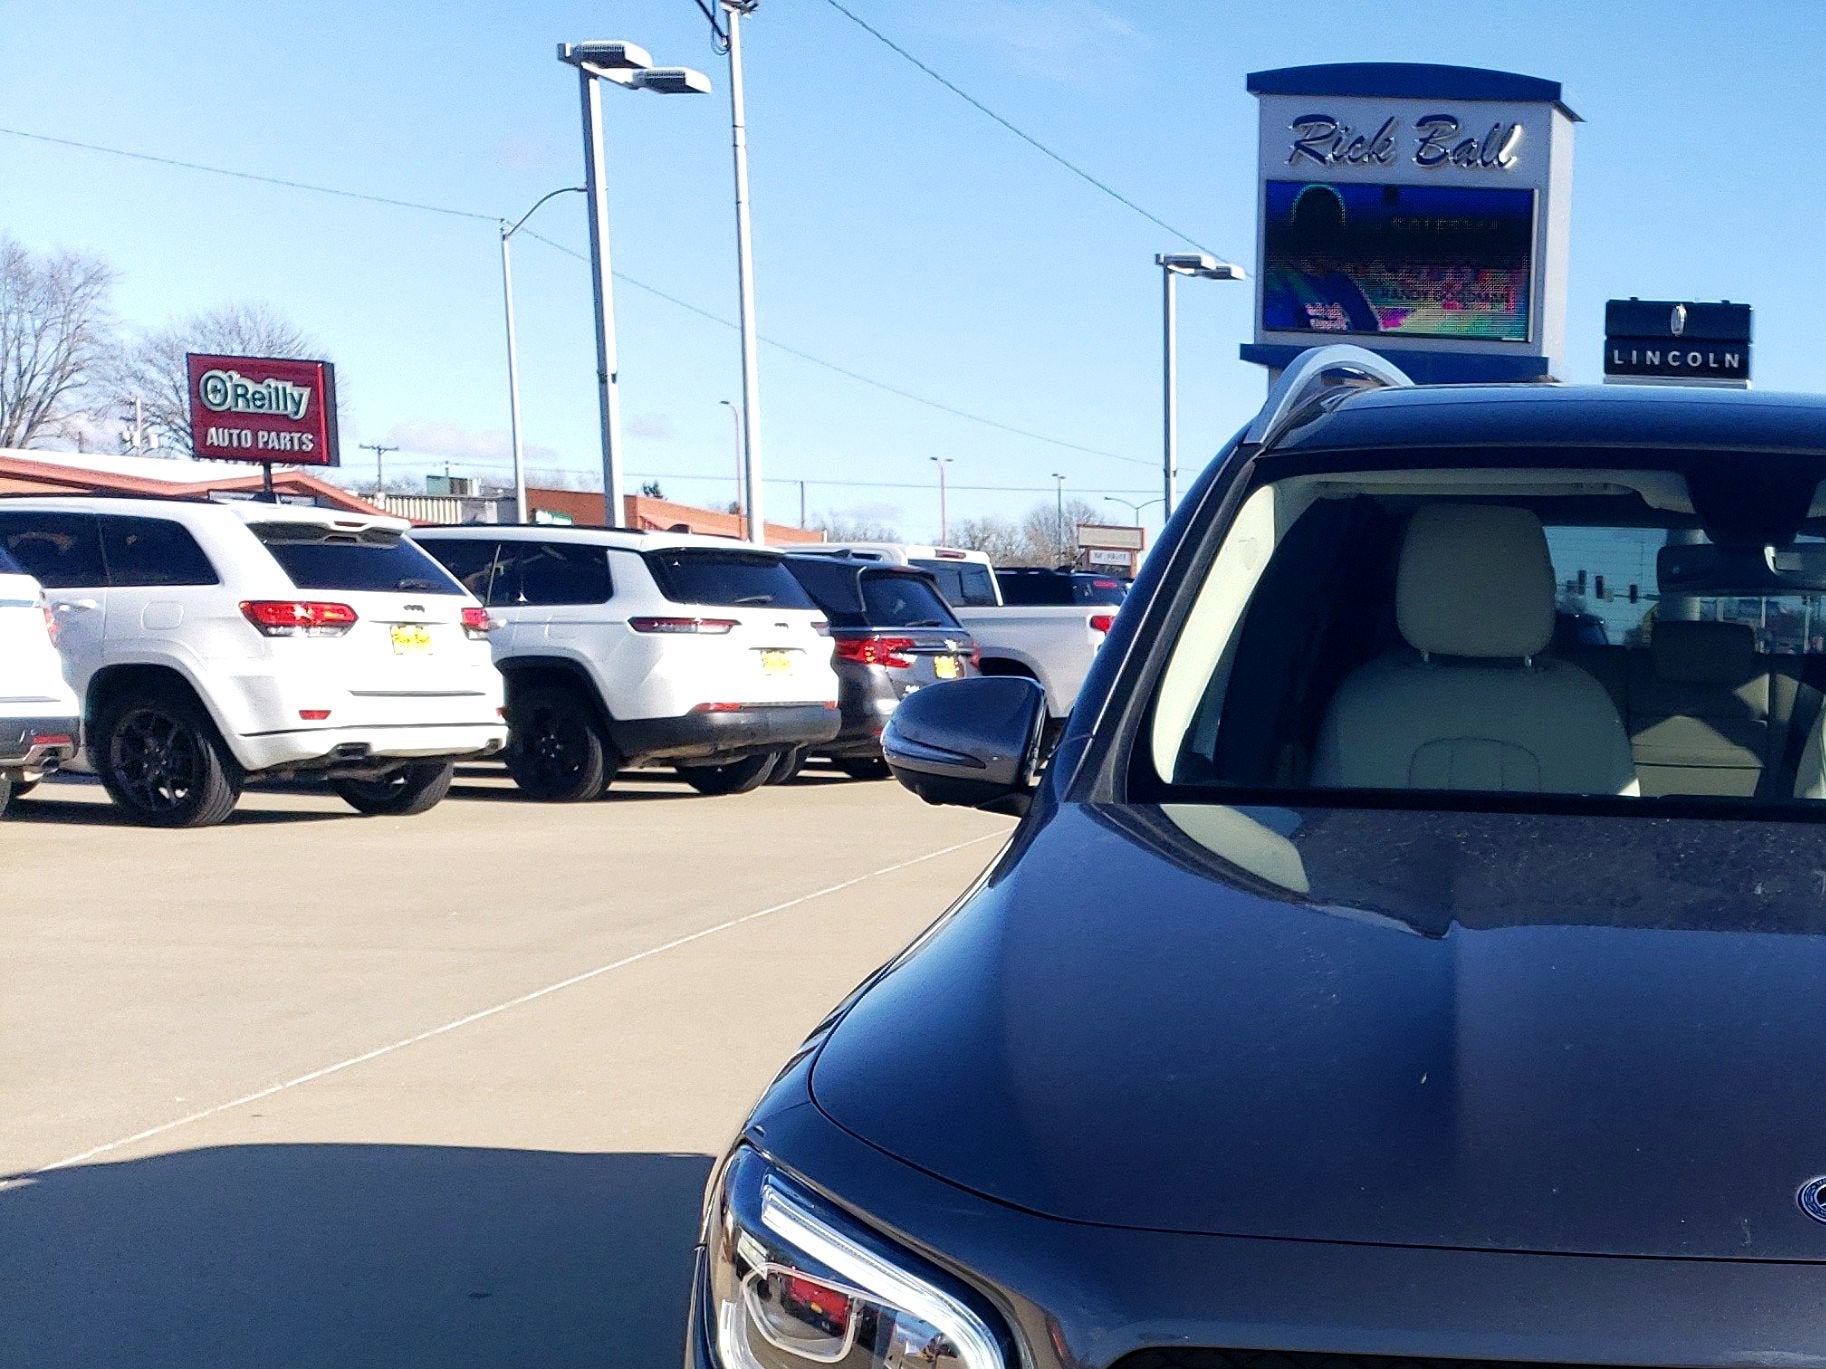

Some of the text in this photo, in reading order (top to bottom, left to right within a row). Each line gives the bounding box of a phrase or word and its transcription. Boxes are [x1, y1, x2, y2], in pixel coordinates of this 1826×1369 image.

[1285, 112, 1524, 171] Rick Ball
[1612, 347, 1741, 369] LINCOLN
[203, 371, 307, 418] O'Reilly
[206, 427, 314, 452] AUTO PARTS
